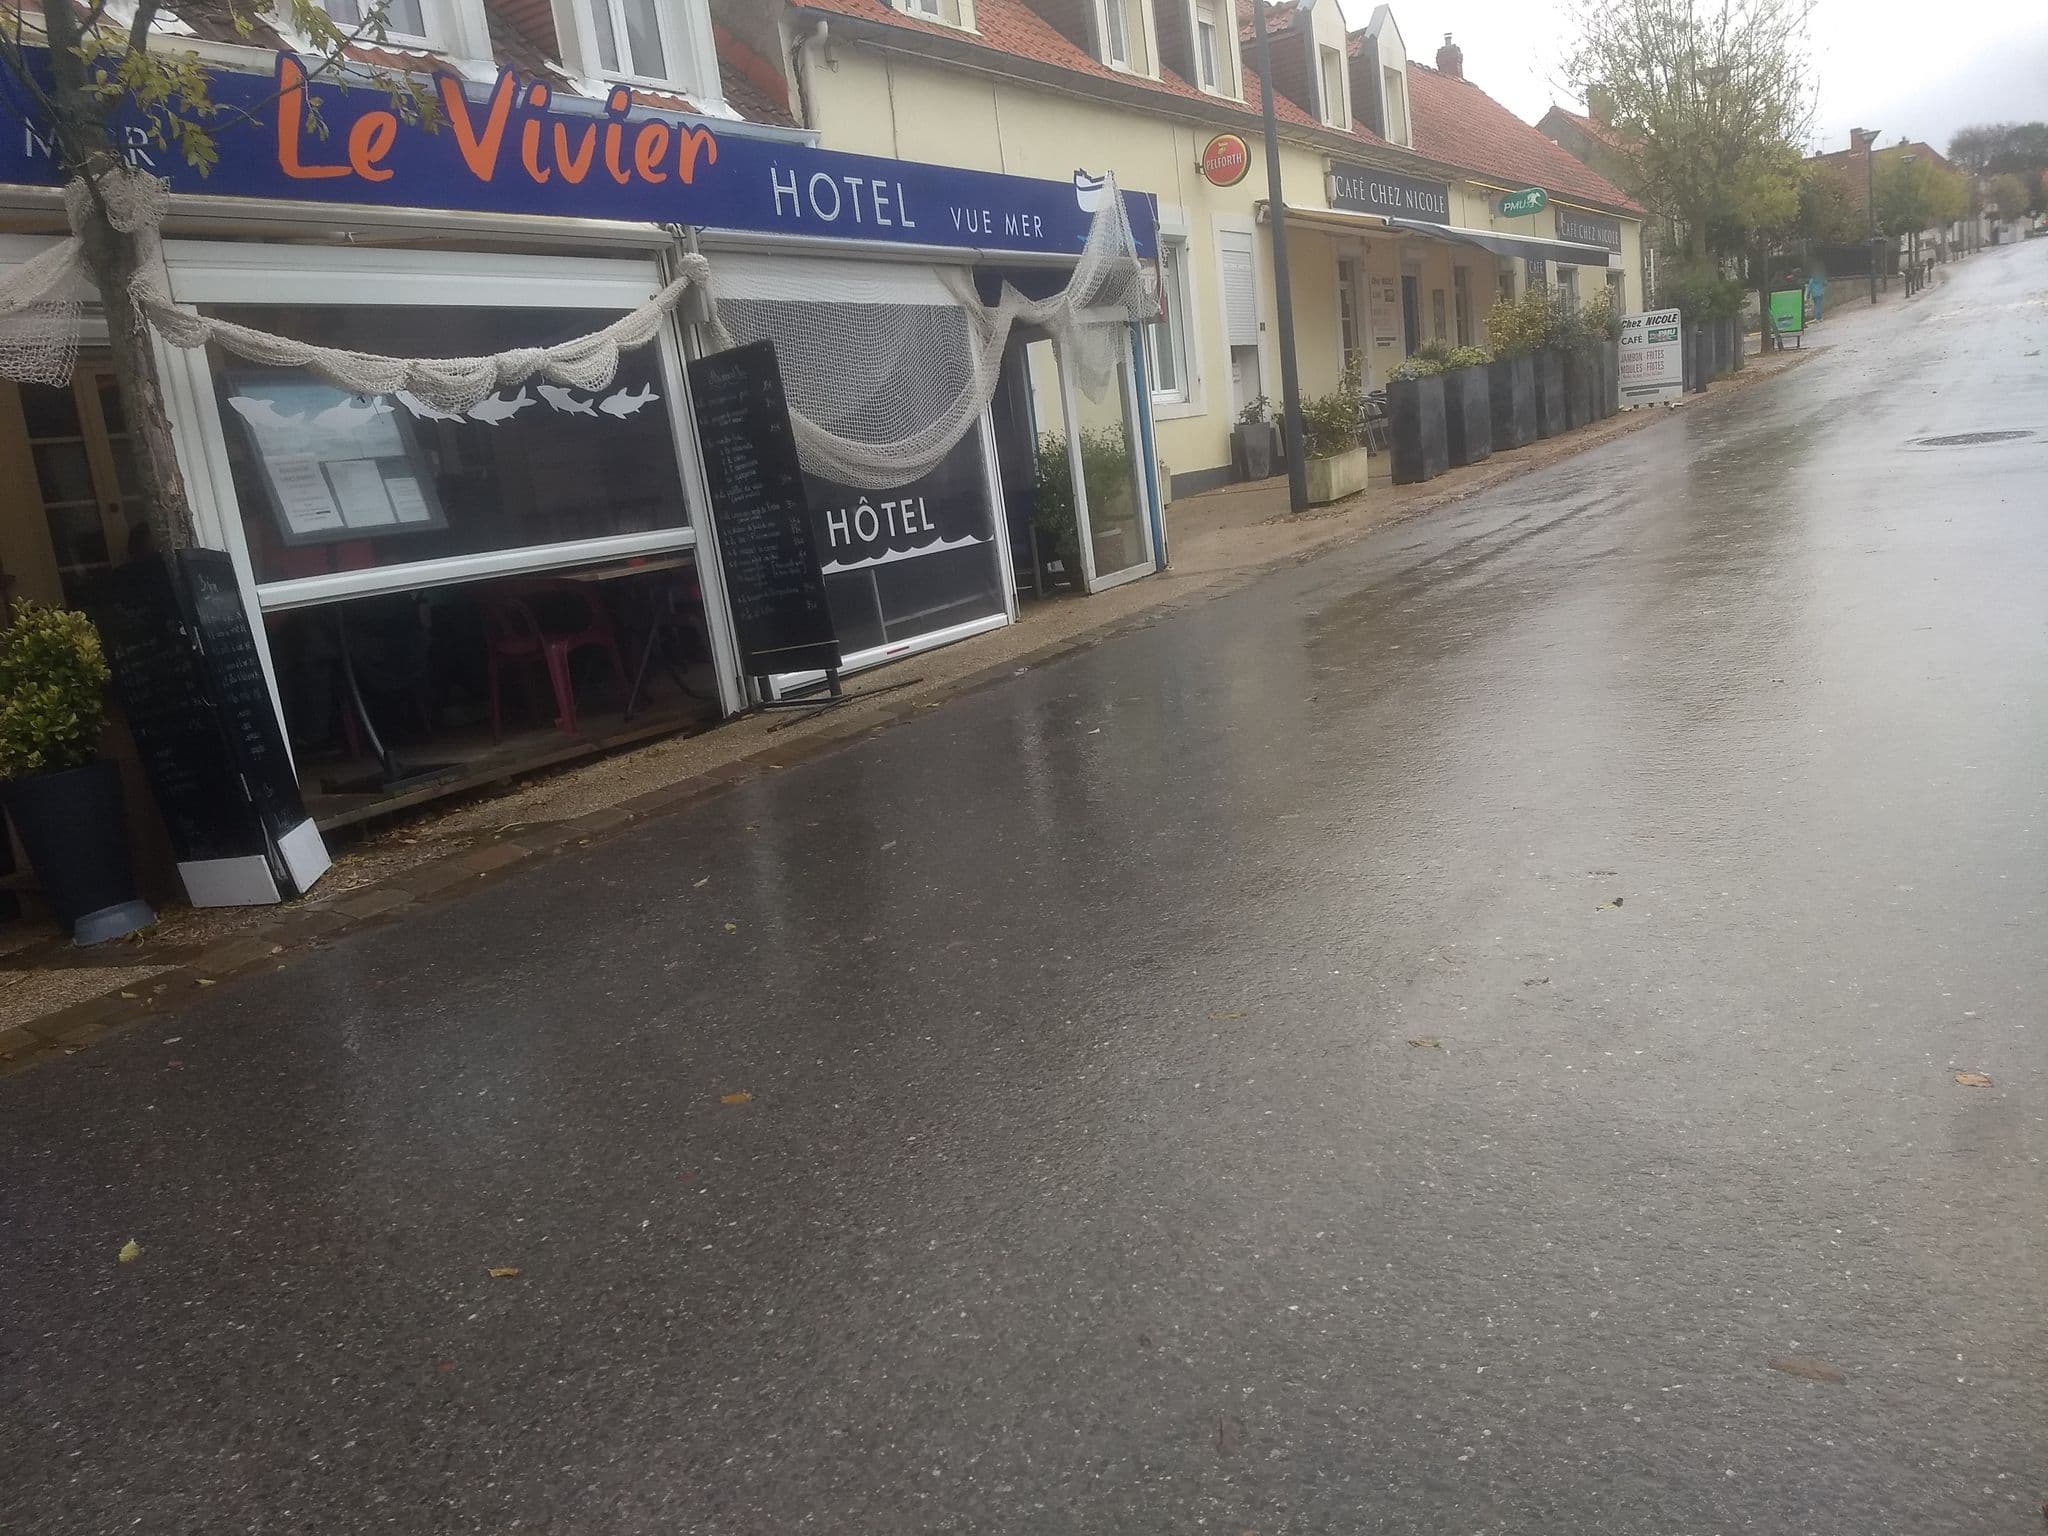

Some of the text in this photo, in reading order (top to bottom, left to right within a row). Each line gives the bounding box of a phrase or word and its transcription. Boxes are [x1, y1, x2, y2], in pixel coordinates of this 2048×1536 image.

[277, 54, 718, 185] Le Vivier
[1206, 152, 1242, 171] PELFORTH
[770, 167, 1044, 239] HOTEL VUE MER
[1336, 175, 1445, 214] CAFÉ CHEZ NICOLE
[1503, 200, 1527, 213] PMU
[1621, 313, 1678, 329] Chez NICOLE
[1646, 349, 1665, 361] FRITES
[1646, 360, 1665, 372] FRITES
[826, 496, 935, 547] HÔTEL
